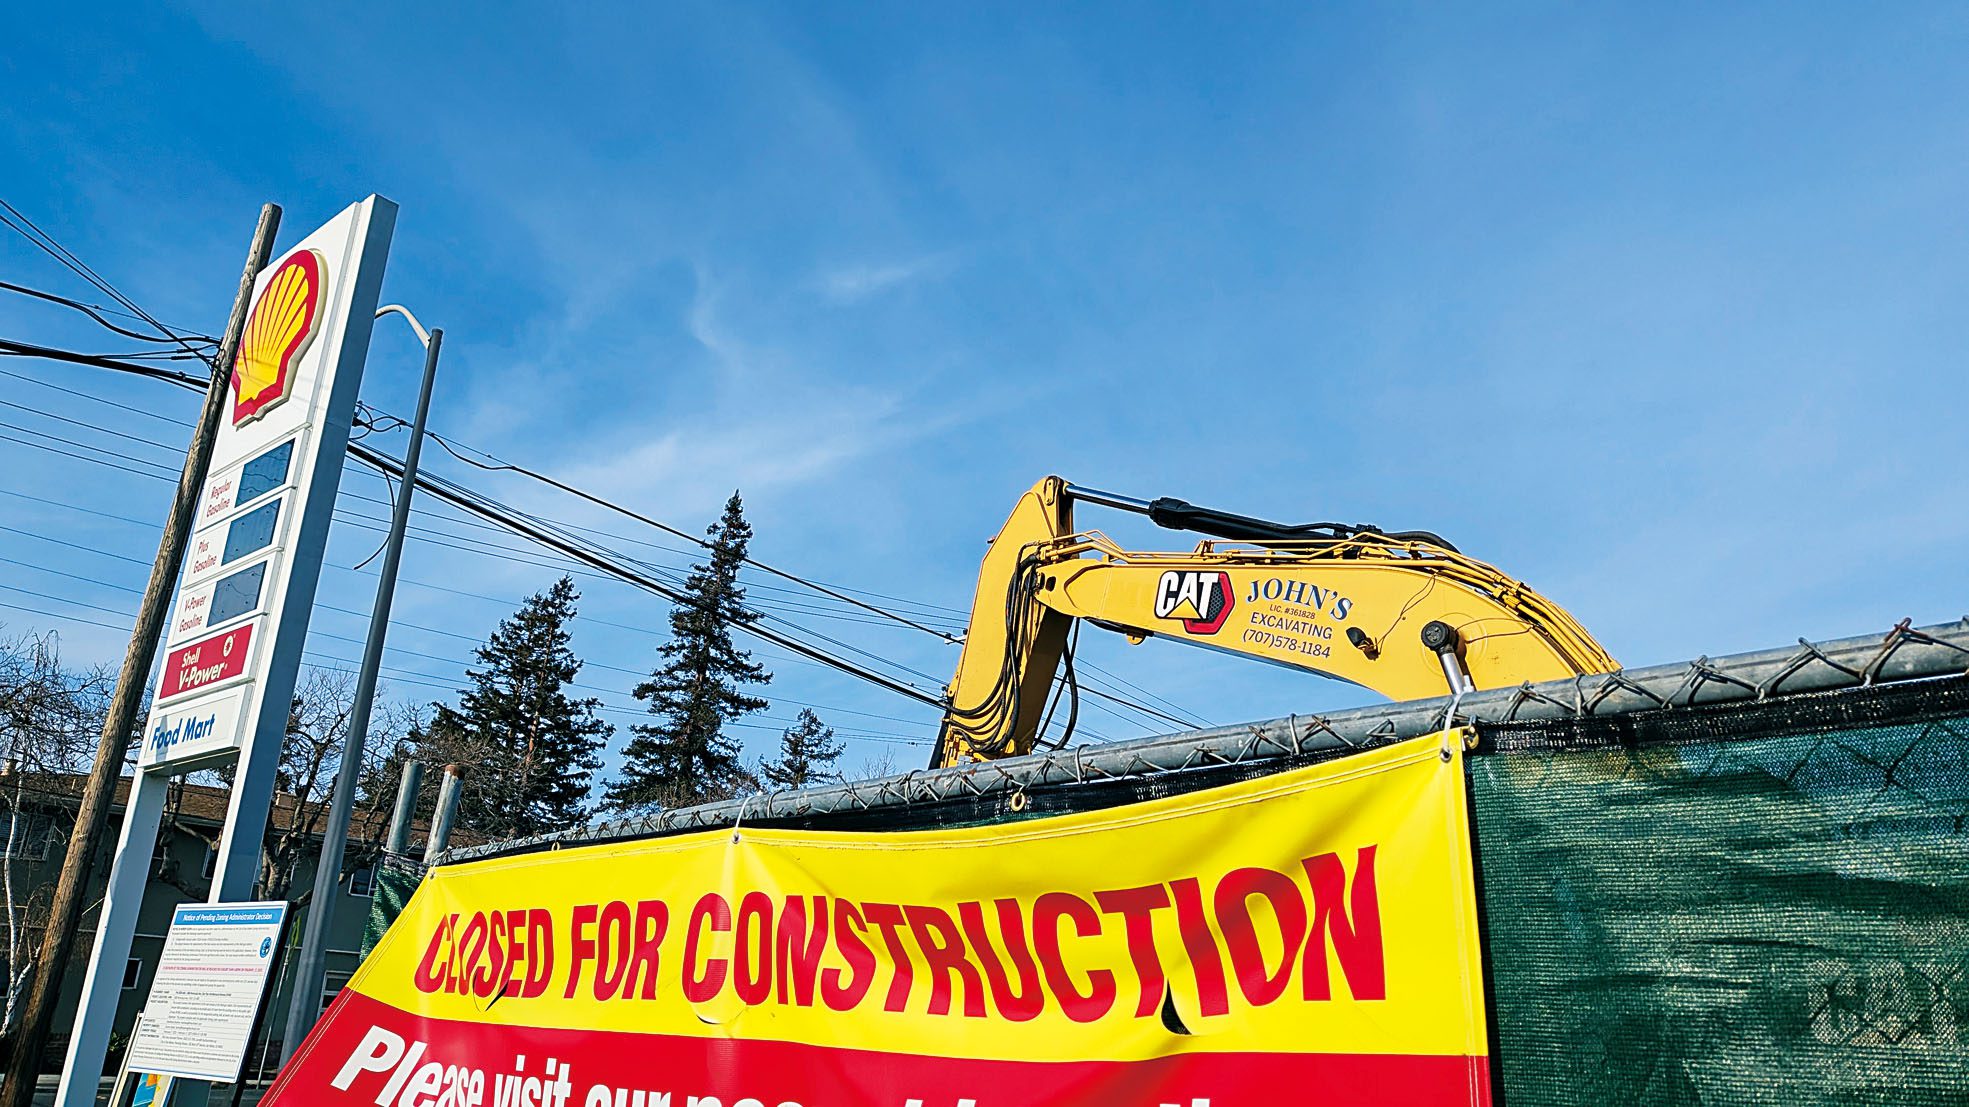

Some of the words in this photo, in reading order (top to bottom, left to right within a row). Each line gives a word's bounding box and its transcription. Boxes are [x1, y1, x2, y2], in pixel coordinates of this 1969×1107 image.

[211, 479, 232, 499] Regular
[206, 498, 230, 518] Gasoline
[198, 539, 209, 554] Plus
[193, 554, 217, 574] Gasoline
[1156, 571, 1219, 619] CAT
[1246, 578, 1354, 621] JOHN'S
[1269, 604, 1283, 613] LIC.
[1284, 607, 1316, 619] #361828
[179, 614, 203, 633] Gasoline
[1250, 612, 1333, 640] EXCAVATING
[1242, 628, 1331, 659] (707)578-1184
[181, 646, 201, 668] Shell
[150, 718, 183, 751] Food
[182, 713, 216, 743] Mart
[196, 913, 202, 921] of
[201, 913, 215, 922] Pending
[216, 914, 228, 922] Zoning
[229, 913, 255, 921] Administrator
[256, 912, 272, 920] Decision
[414, 908, 554, 998] CLOSED
[563, 899, 669, 1002] FOR
[681, 845, 1386, 1025] CONSTRUCTION
[330, 1024, 485, 1107] Please
